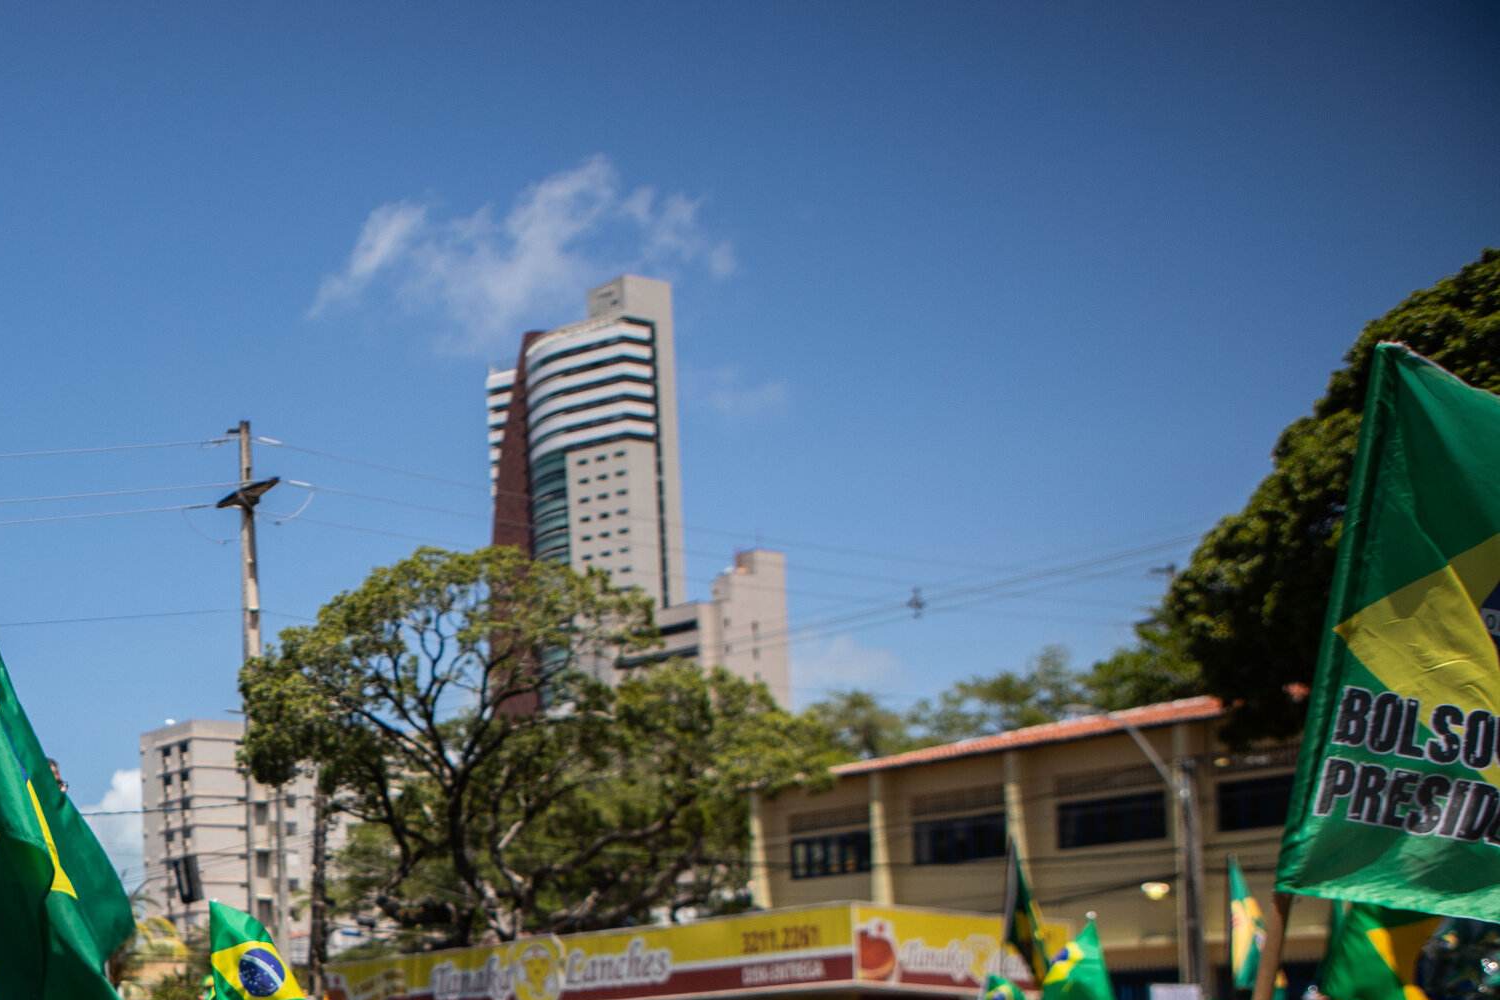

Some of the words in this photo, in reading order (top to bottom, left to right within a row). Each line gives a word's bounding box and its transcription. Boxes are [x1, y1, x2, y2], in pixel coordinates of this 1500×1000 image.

[1332, 685, 1500, 769] BOLSO
[1312, 756, 1500, 847] PRESID
[561, 937, 672, 988] Lanches
